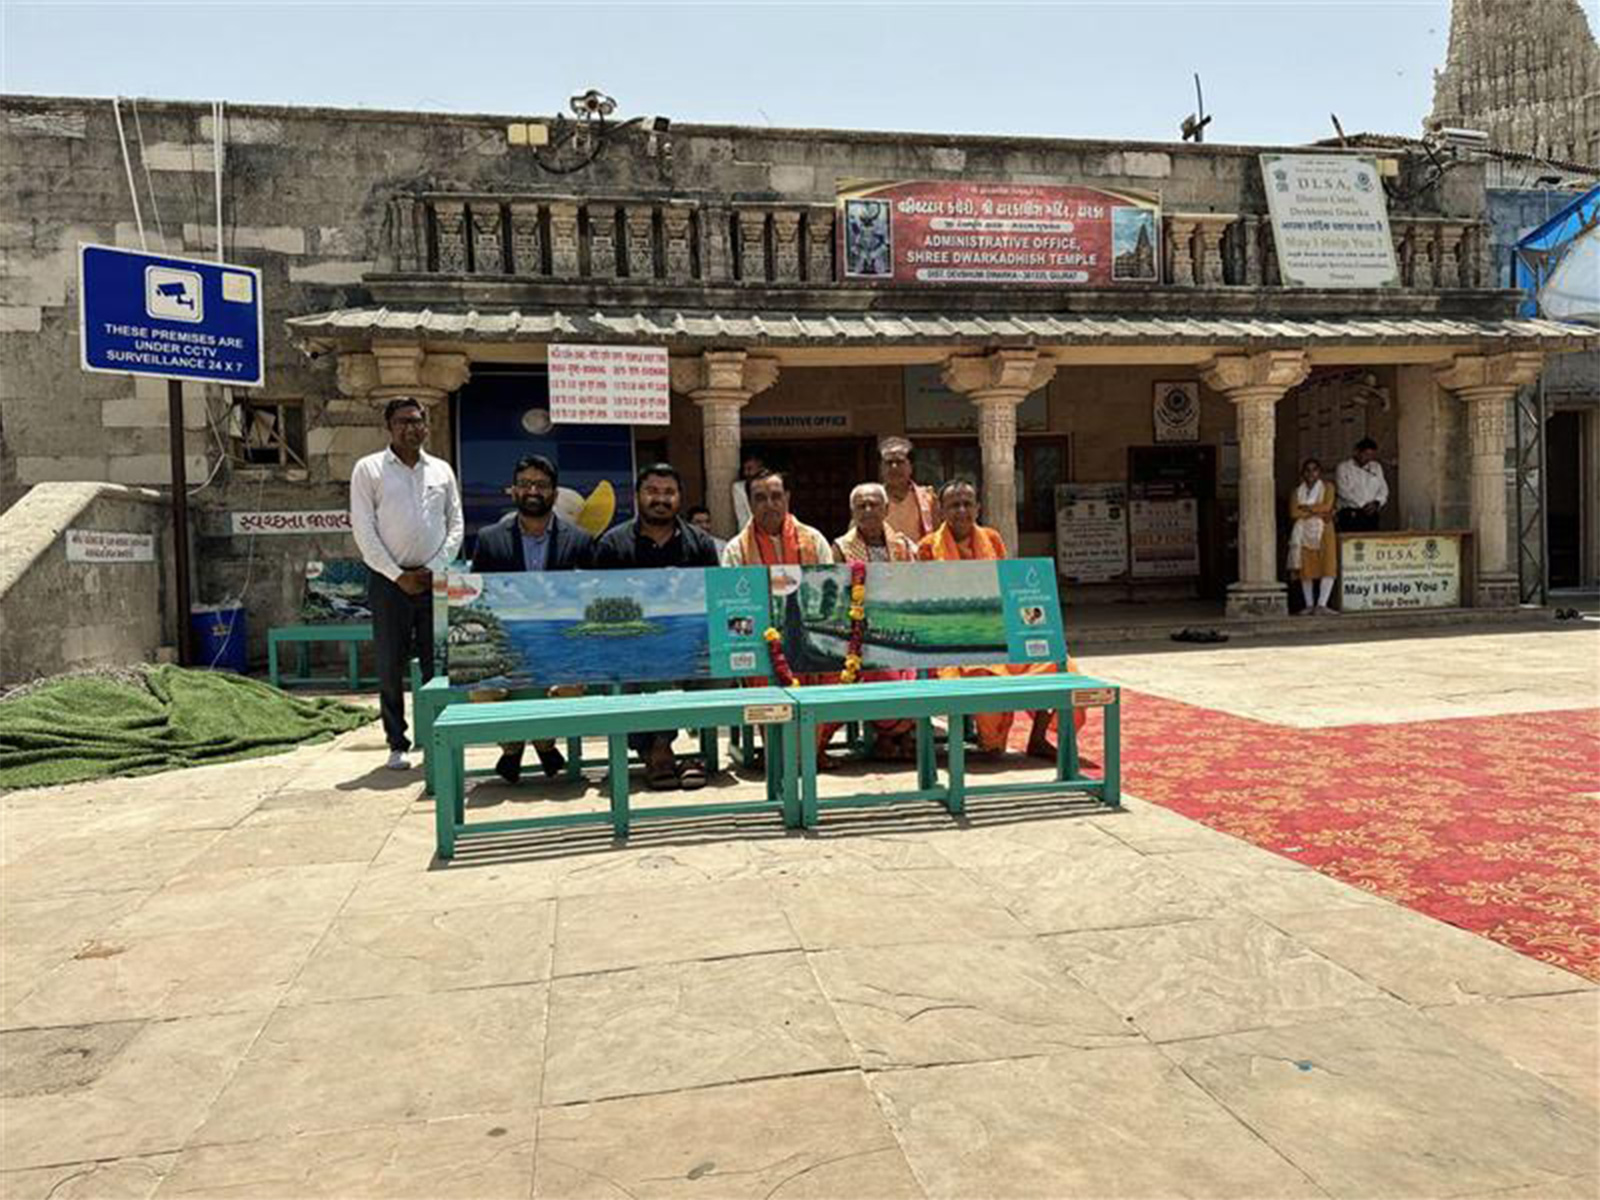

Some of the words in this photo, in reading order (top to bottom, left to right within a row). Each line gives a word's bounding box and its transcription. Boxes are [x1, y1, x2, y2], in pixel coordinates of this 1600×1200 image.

[925, 235, 1030, 249] ADMINISTRATIVE
[1033, 236, 1081, 251] OFFICE,
[907, 250, 949, 264] SHREE
[952, 251, 1046, 265] DWARKADHISH
[1049, 253, 1098, 266] TEMPLE
[104, 323, 149, 339] THESE
[151, 328, 215, 346] PREMISES
[217, 334, 243, 348] ARE
[135, 340, 181, 355] UNDER
[183, 344, 218, 358] CCTV
[106, 350, 205, 369] SURVEILLANCE
[207, 359, 222, 370] 24
[224, 361, 233, 371] X
[236, 362, 243, 372] 7
[1344, 583, 1371, 597] May
[1374, 583, 1379, 594] I
[1382, 582, 1411, 596] Help
[1415, 581, 1438, 592] You
[1441, 580, 1449, 591] ?
